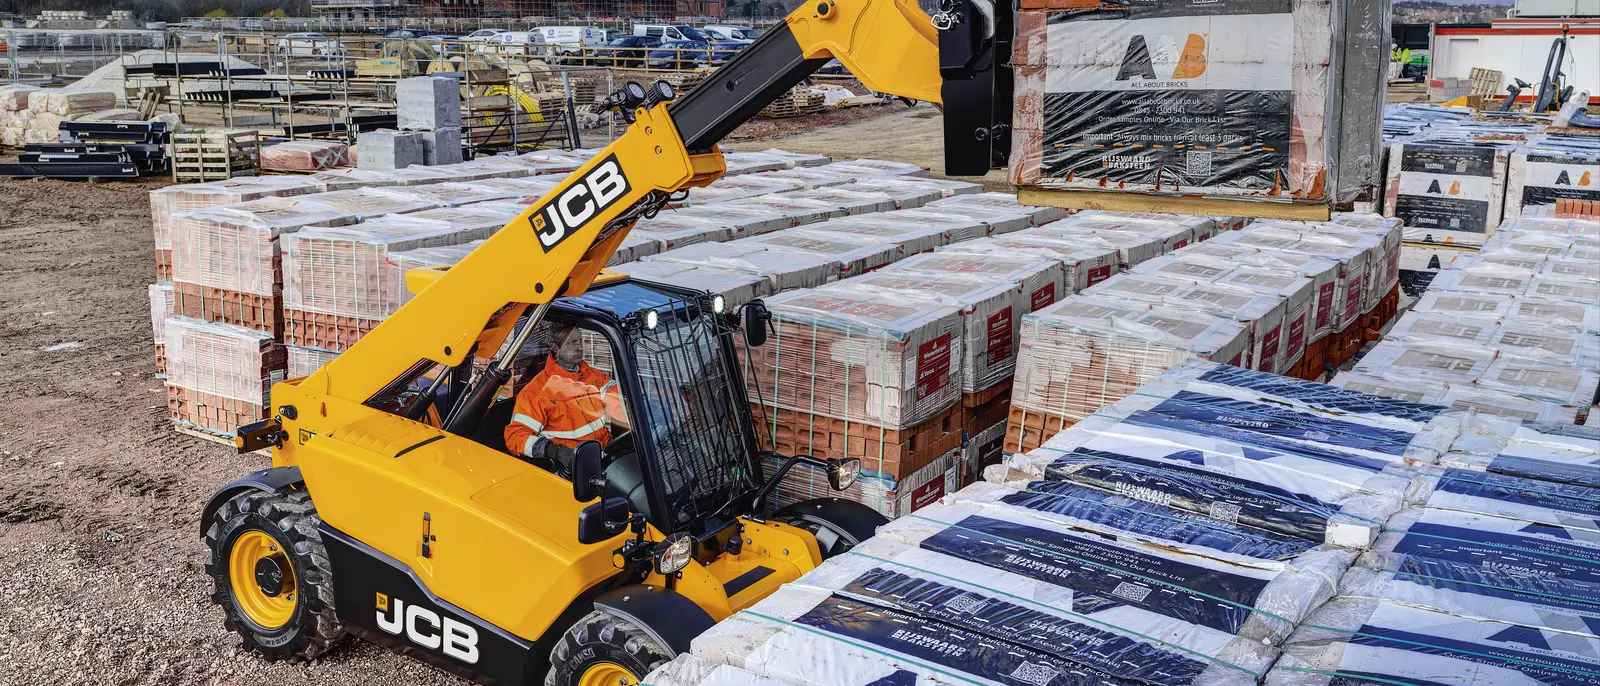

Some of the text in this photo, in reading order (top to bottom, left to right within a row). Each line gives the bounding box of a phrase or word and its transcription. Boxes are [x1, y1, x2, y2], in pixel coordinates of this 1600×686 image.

[1082, 133, 1113, 141] Important
[1224, 134, 1243, 142] packs
[540, 161, 626, 246] JCB
[1116, 482, 1171, 500] RIJSWAARD
[996, 540, 1034, 552] Important
[1063, 538, 1162, 565] www.allaboutbricks.co.uk
[1100, 551, 1121, 560] 2300
[1126, 545, 1153, 554] BRICKS
[1458, 546, 1503, 555] Important
[1510, 552, 1543, 562] Always
[1007, 554, 1071, 574] RIJSWAARD
[1024, 537, 1046, 546] Order
[1048, 543, 1080, 555] Samples
[1082, 552, 1109, 561] Online
[1146, 568, 1168, 577] Brick
[376, 598, 479, 664] JCB
[896, 629, 966, 652] RIJSWAARD
[883, 610, 928, 624] Important
[933, 623, 964, 635] Always
[966, 632, 983, 640] mix
[985, 637, 1011, 649] bricks
[1013, 645, 1036, 657] from
[1050, 657, 1074, 667] least
[1084, 667, 1112, 679] packs
[900, 636, 963, 657] BAKSTEEN
[1528, 648, 1565, 657] ABOUT
[571, 648, 596, 670] CAMSO
[1444, 652, 1473, 661] Order
[1476, 657, 1520, 671] Samples
[1521, 666, 1558, 677] Online
